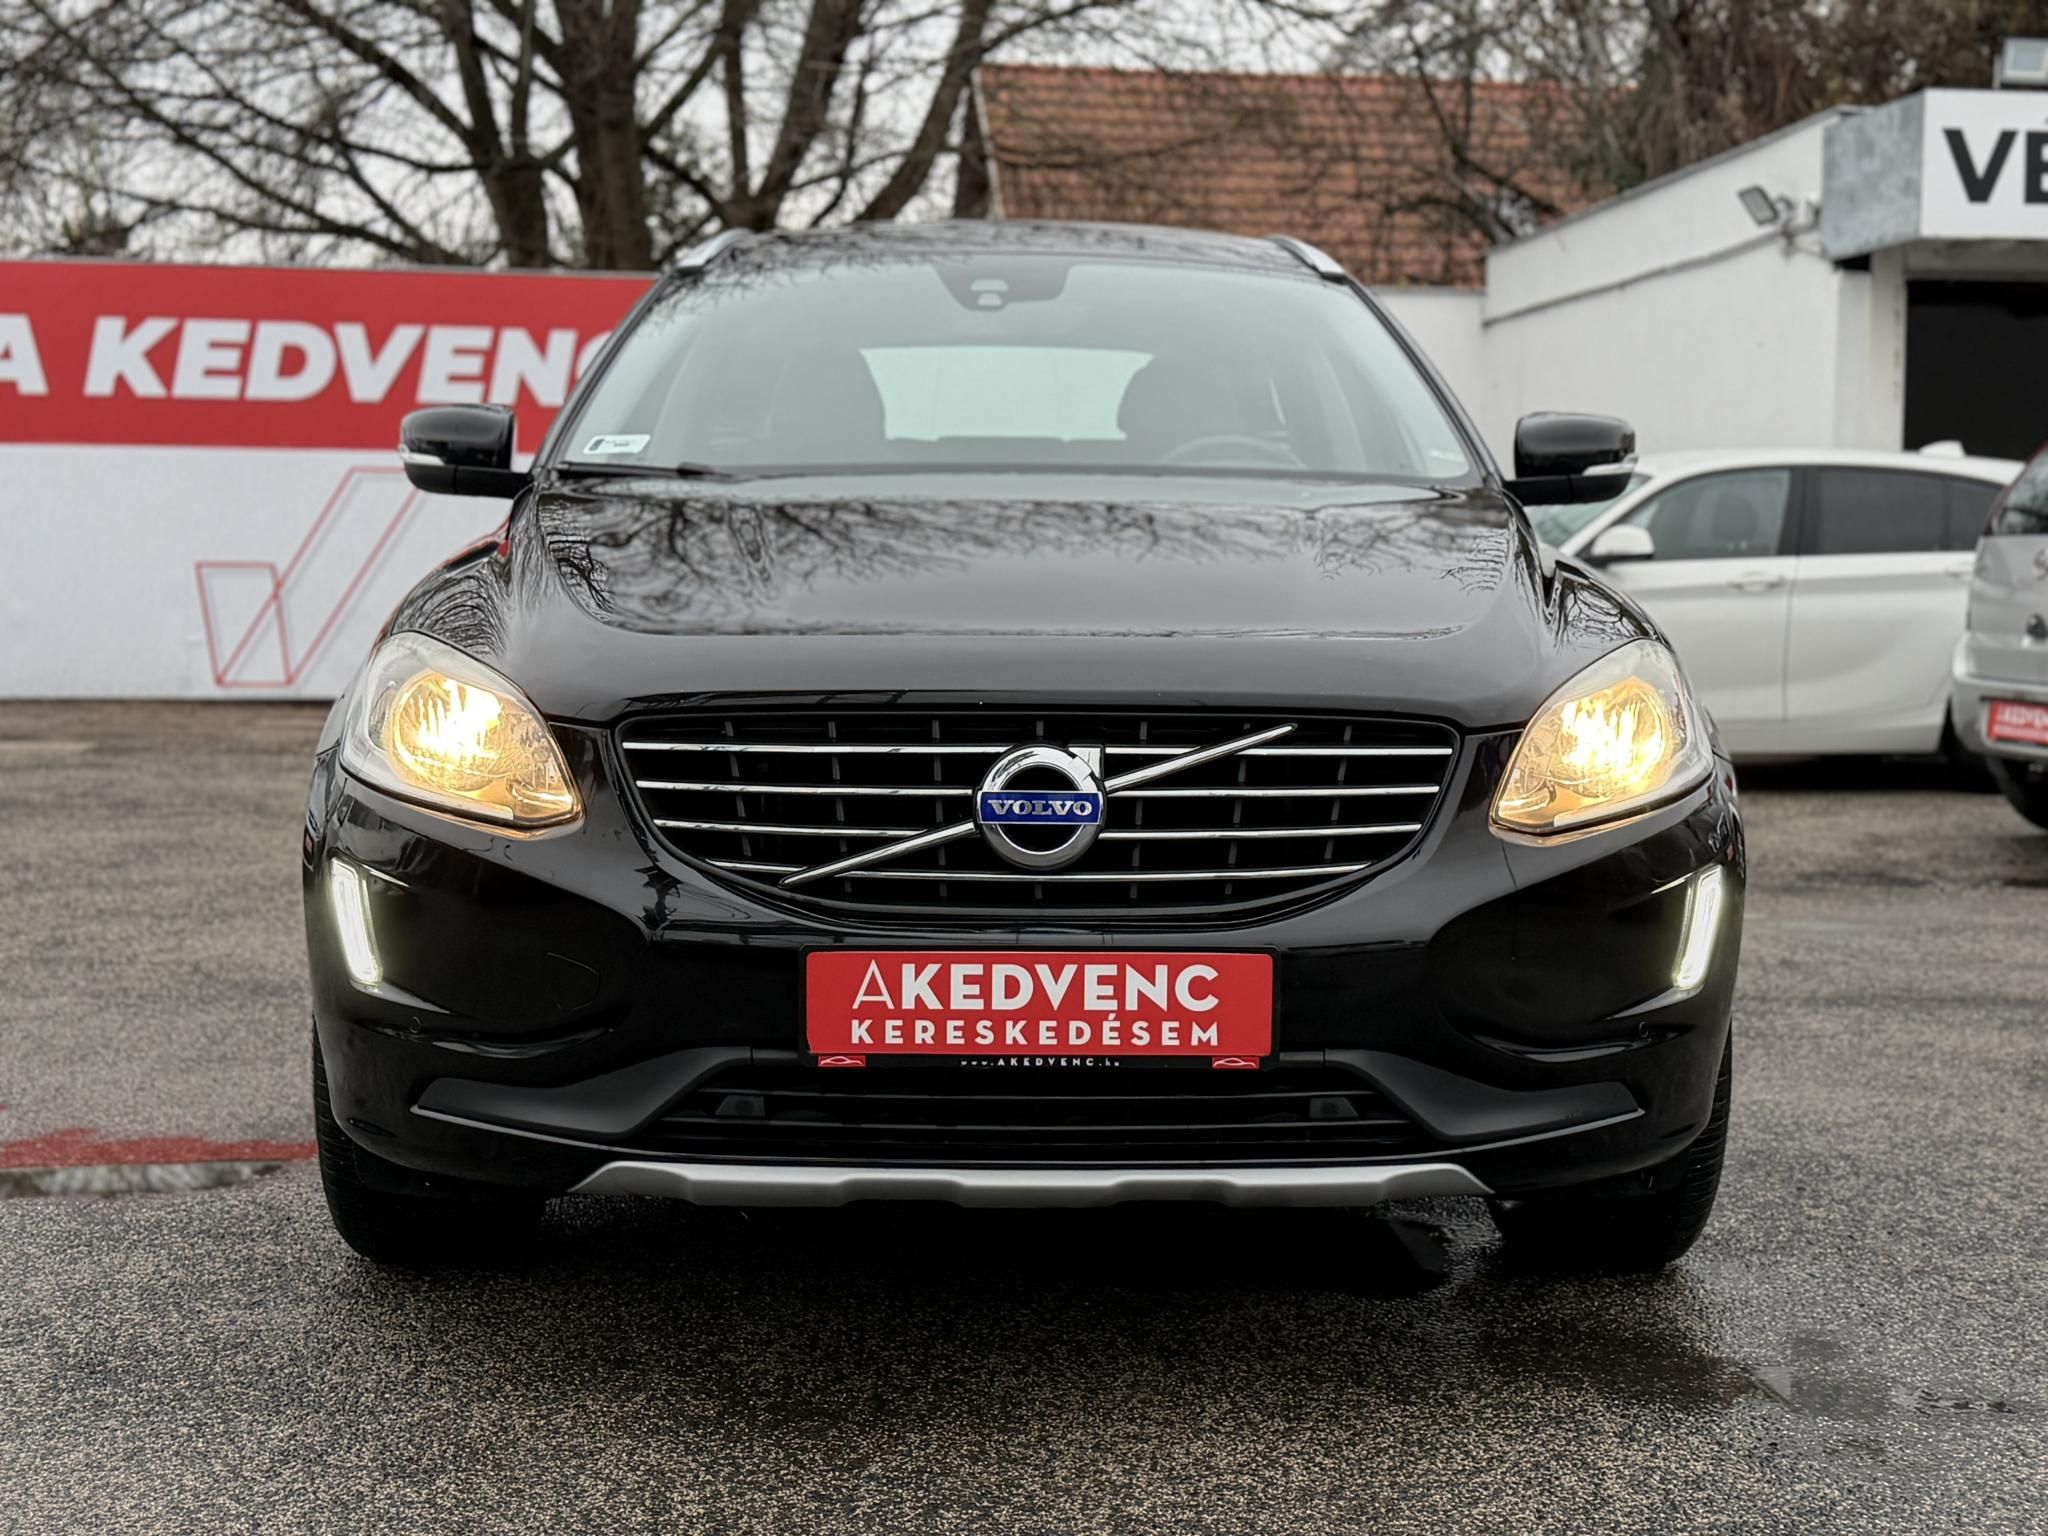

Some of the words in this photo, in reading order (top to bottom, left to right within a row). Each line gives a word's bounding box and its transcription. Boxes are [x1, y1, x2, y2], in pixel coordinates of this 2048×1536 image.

[987, 799, 1093, 816] VOLVO
[851, 959, 1220, 1012] AKEDVENC
[851, 1013, 1219, 1047] KERESKEDÉSEM
